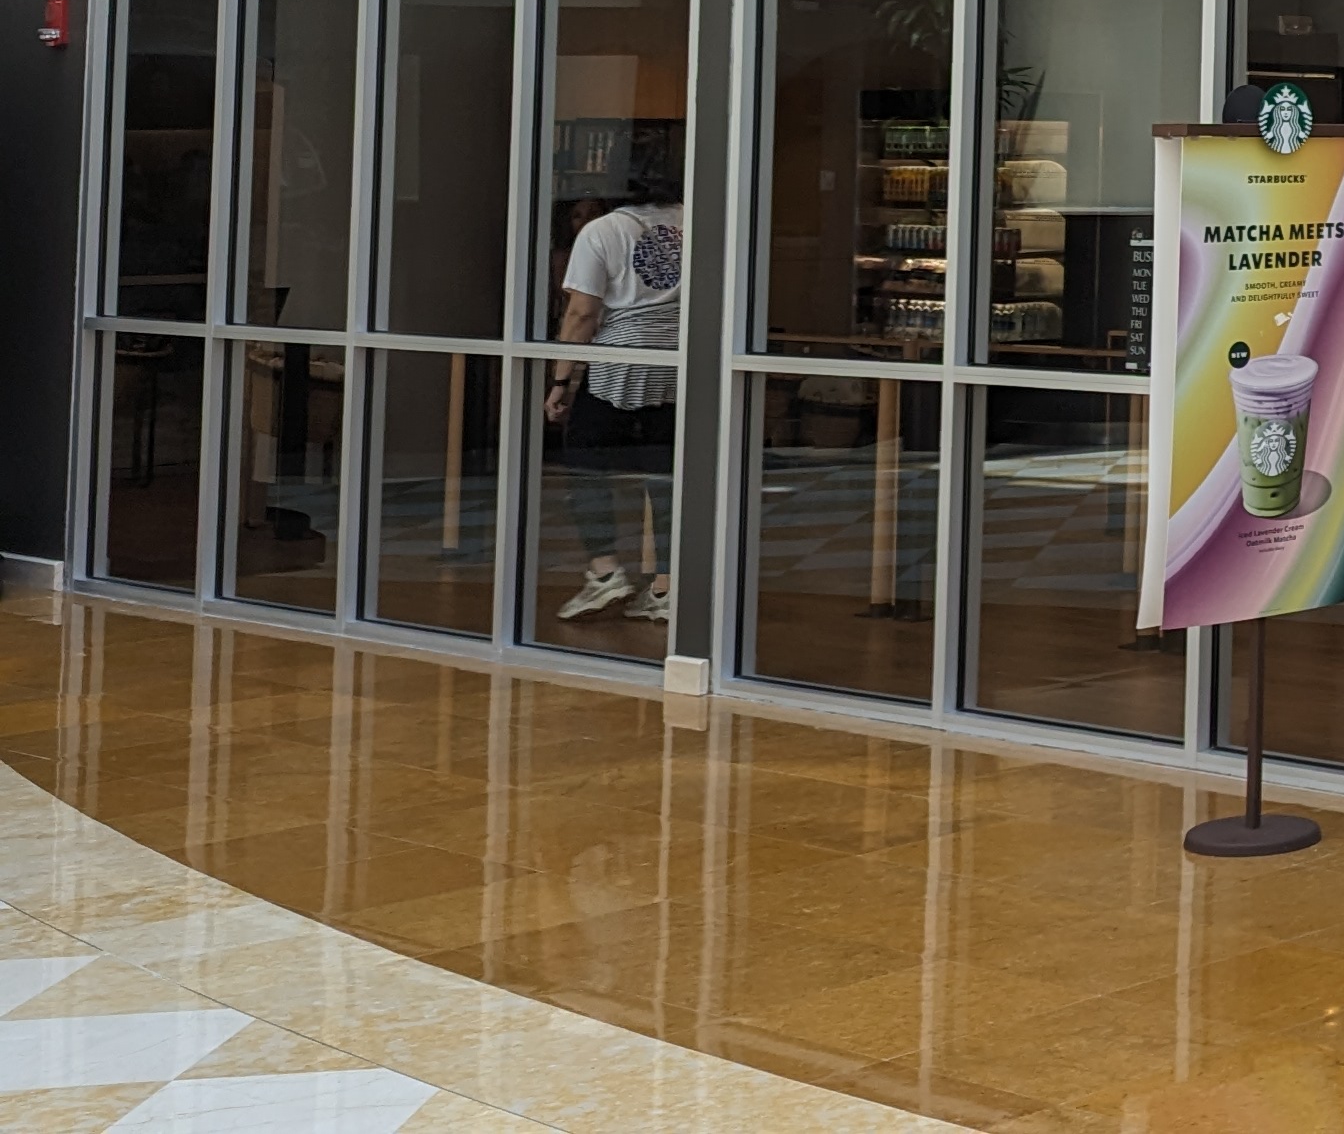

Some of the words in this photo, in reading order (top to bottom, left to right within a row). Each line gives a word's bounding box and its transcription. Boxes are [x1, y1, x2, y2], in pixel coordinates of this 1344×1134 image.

[1247, 175, 1306, 184] STARBUCKS
[1203, 224, 1284, 243] MATCHA
[1288, 222, 1344, 241] MEETS
[1228, 250, 1323, 271] LAVENDER
[1132, 268, 1151, 277] MON
[1132, 281, 1147, 291] TUE
[1131, 294, 1150, 304] WED
[1230, 295, 1246, 303] AND
[1131, 307, 1148, 316] THU
[1130, 319, 1143, 329] FRI
[1130, 332, 1144, 342] SAT
[1129, 345, 1146, 355] SUN
[1253, 527, 1284, 537] Lavender
[1273, 535, 1297, 543] Matcha
